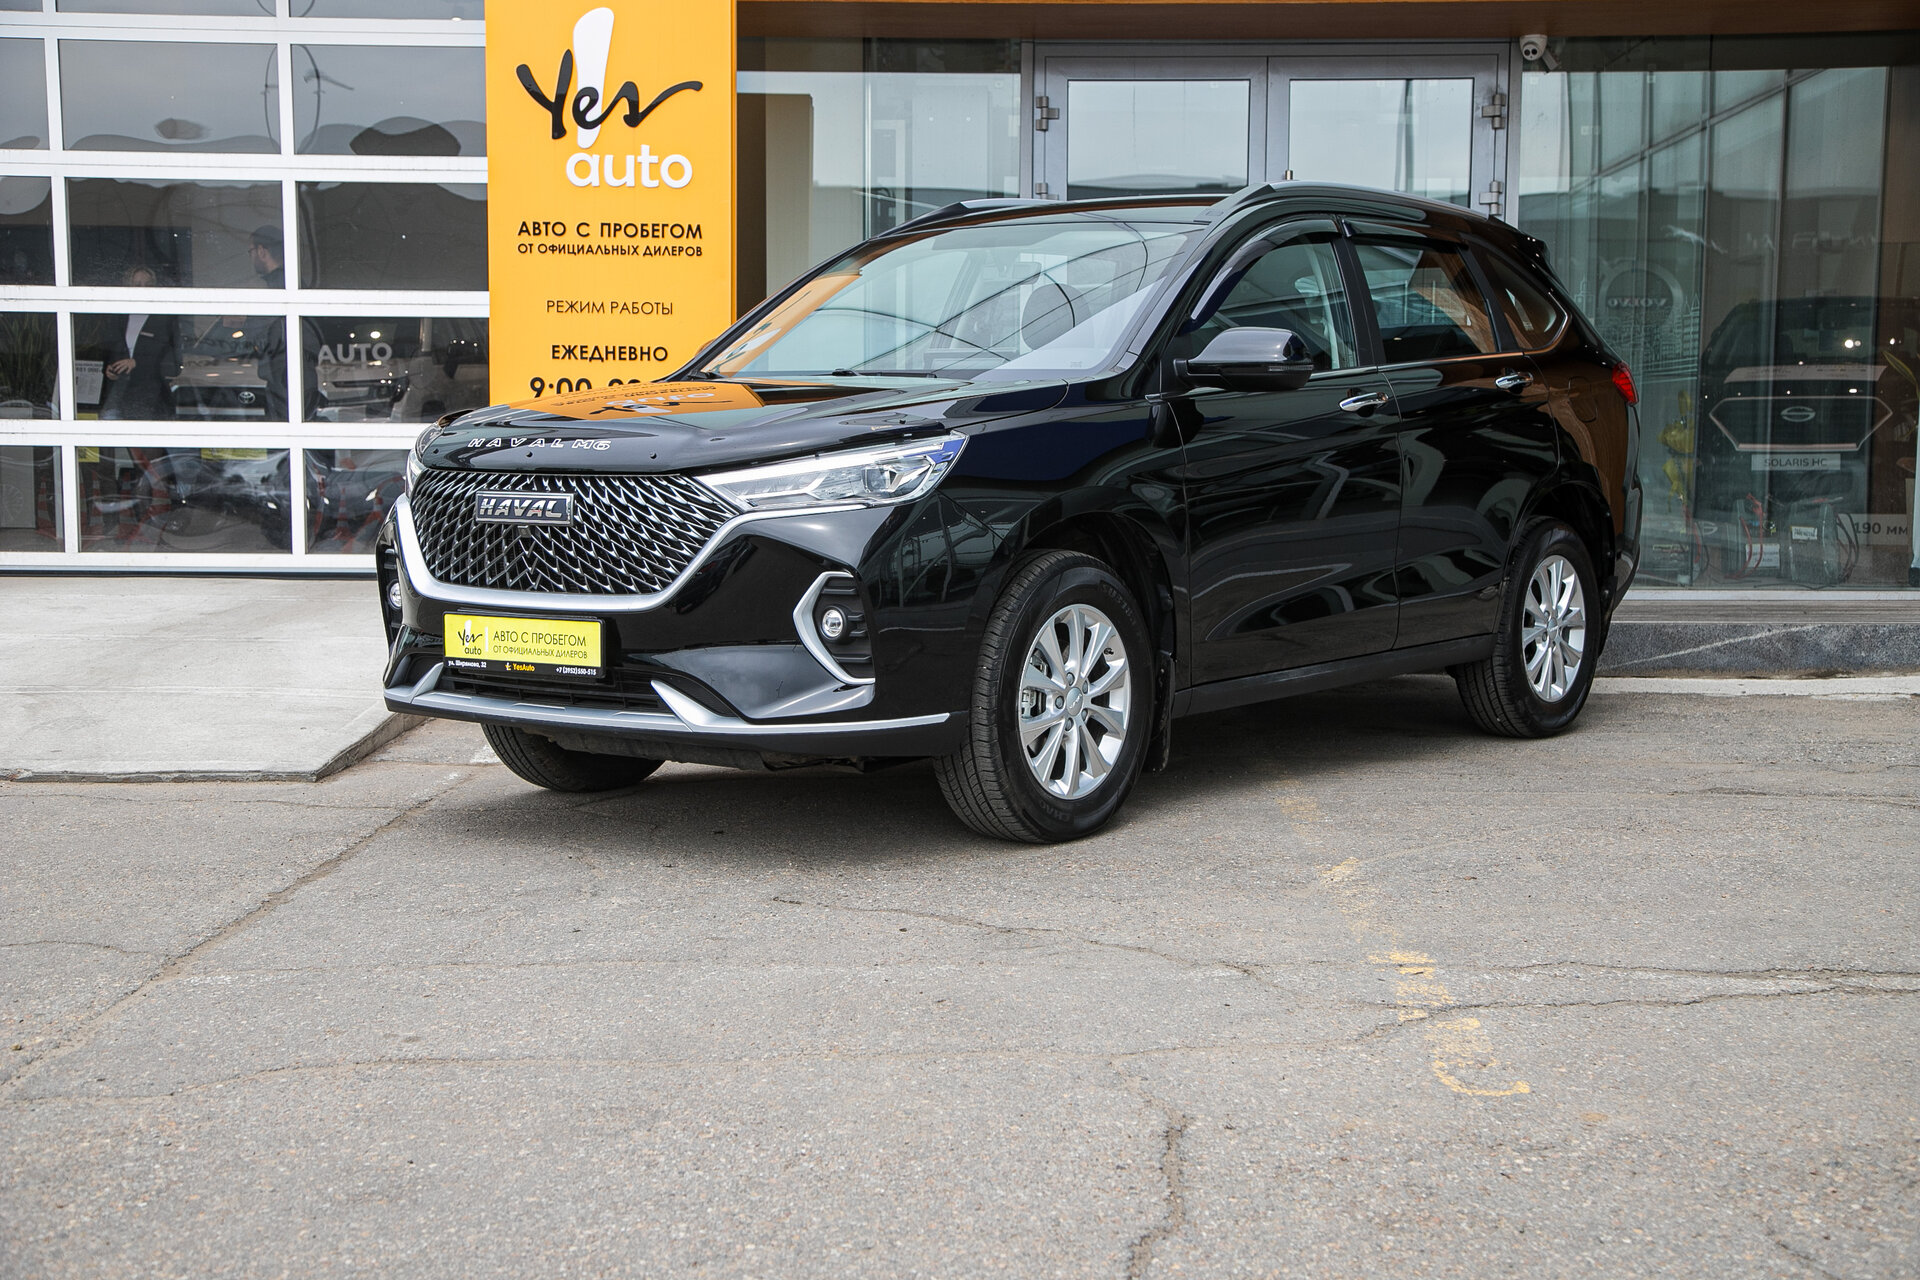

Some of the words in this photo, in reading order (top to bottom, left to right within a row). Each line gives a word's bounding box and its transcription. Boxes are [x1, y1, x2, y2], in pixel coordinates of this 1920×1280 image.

[516, 49, 703, 139] Yes
[566, 144, 693, 188] auto
[517, 221, 567, 237] АВТО
[576, 222, 590, 238] С
[600, 222, 703, 239] ПРОБЕГОМ
[517, 243, 533, 254] ОТ
[537, 243, 639, 256] ОФИЦИАЛЬНЫХ
[643, 245, 703, 257] ДИЛЕРОВ
[546, 300, 605, 314] РЕЖИМ
[610, 301, 673, 315] РАБОТЫ
[318, 342, 393, 365] AUTO
[551, 344, 668, 362] ЕЖЕДНЕВНО
[468, 438, 564, 448] HAVAL
[571, 439, 612, 450] M6
[1764, 458, 1809, 467] SOLARIS
[479, 498, 562, 518] HAVAL
[493, 631, 518, 643] АВТО
[521, 632, 529, 643] С
[531, 633, 587, 647] ПРОБЕГОМ
[464, 646, 482, 655] auto
[493, 645, 502, 654] ОТ
[505, 646, 554, 657] ОФИЦИАЛЬНЫХ
[555, 649, 588, 659] ДИЛЕРОВ
[512, 662, 535, 672] YesAuto
